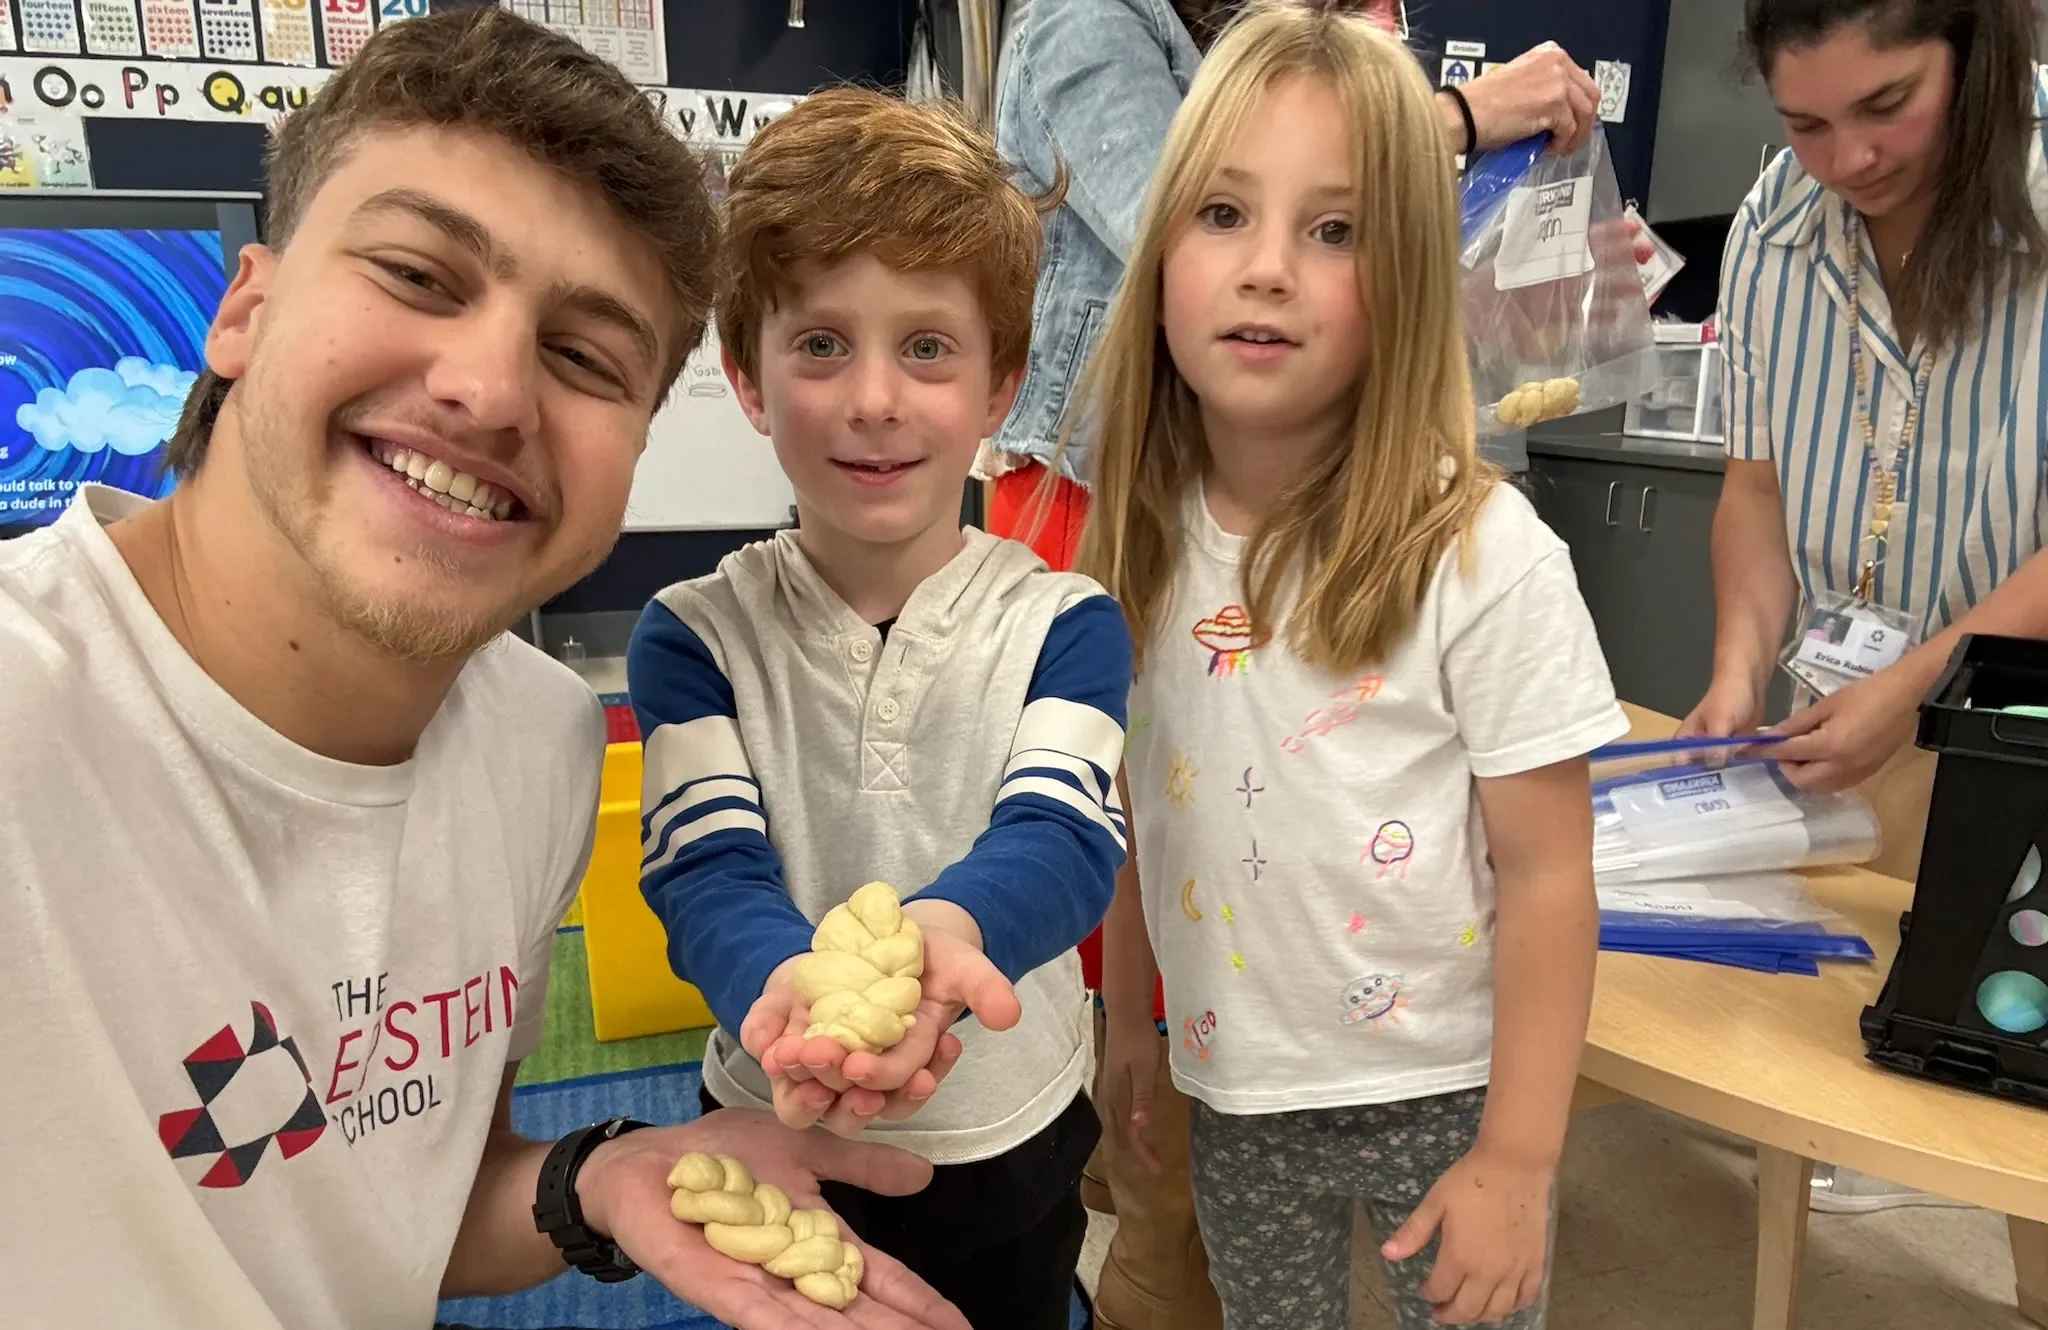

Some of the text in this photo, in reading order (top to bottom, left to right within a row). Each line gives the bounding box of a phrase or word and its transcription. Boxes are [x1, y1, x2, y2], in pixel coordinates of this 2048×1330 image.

[21, 0, 72, 10] fourteen
[89, 3, 129, 13] fifteen
[147, 5, 189, 15] sixteen
[201, 9, 252, 18] seventeen
[327, 16, 368, 25] nineteen
[0, 480, 26, 492] uld
[28, 478, 56, 492] talk
[58, 480, 74, 491] to
[10, 497, 46, 510] dude
[48, 496, 62, 508] in
[1815, 651, 1841, 666] Erica
[331, 972, 389, 1022] THE
[332, 1074, 442, 1147] CHOOL
